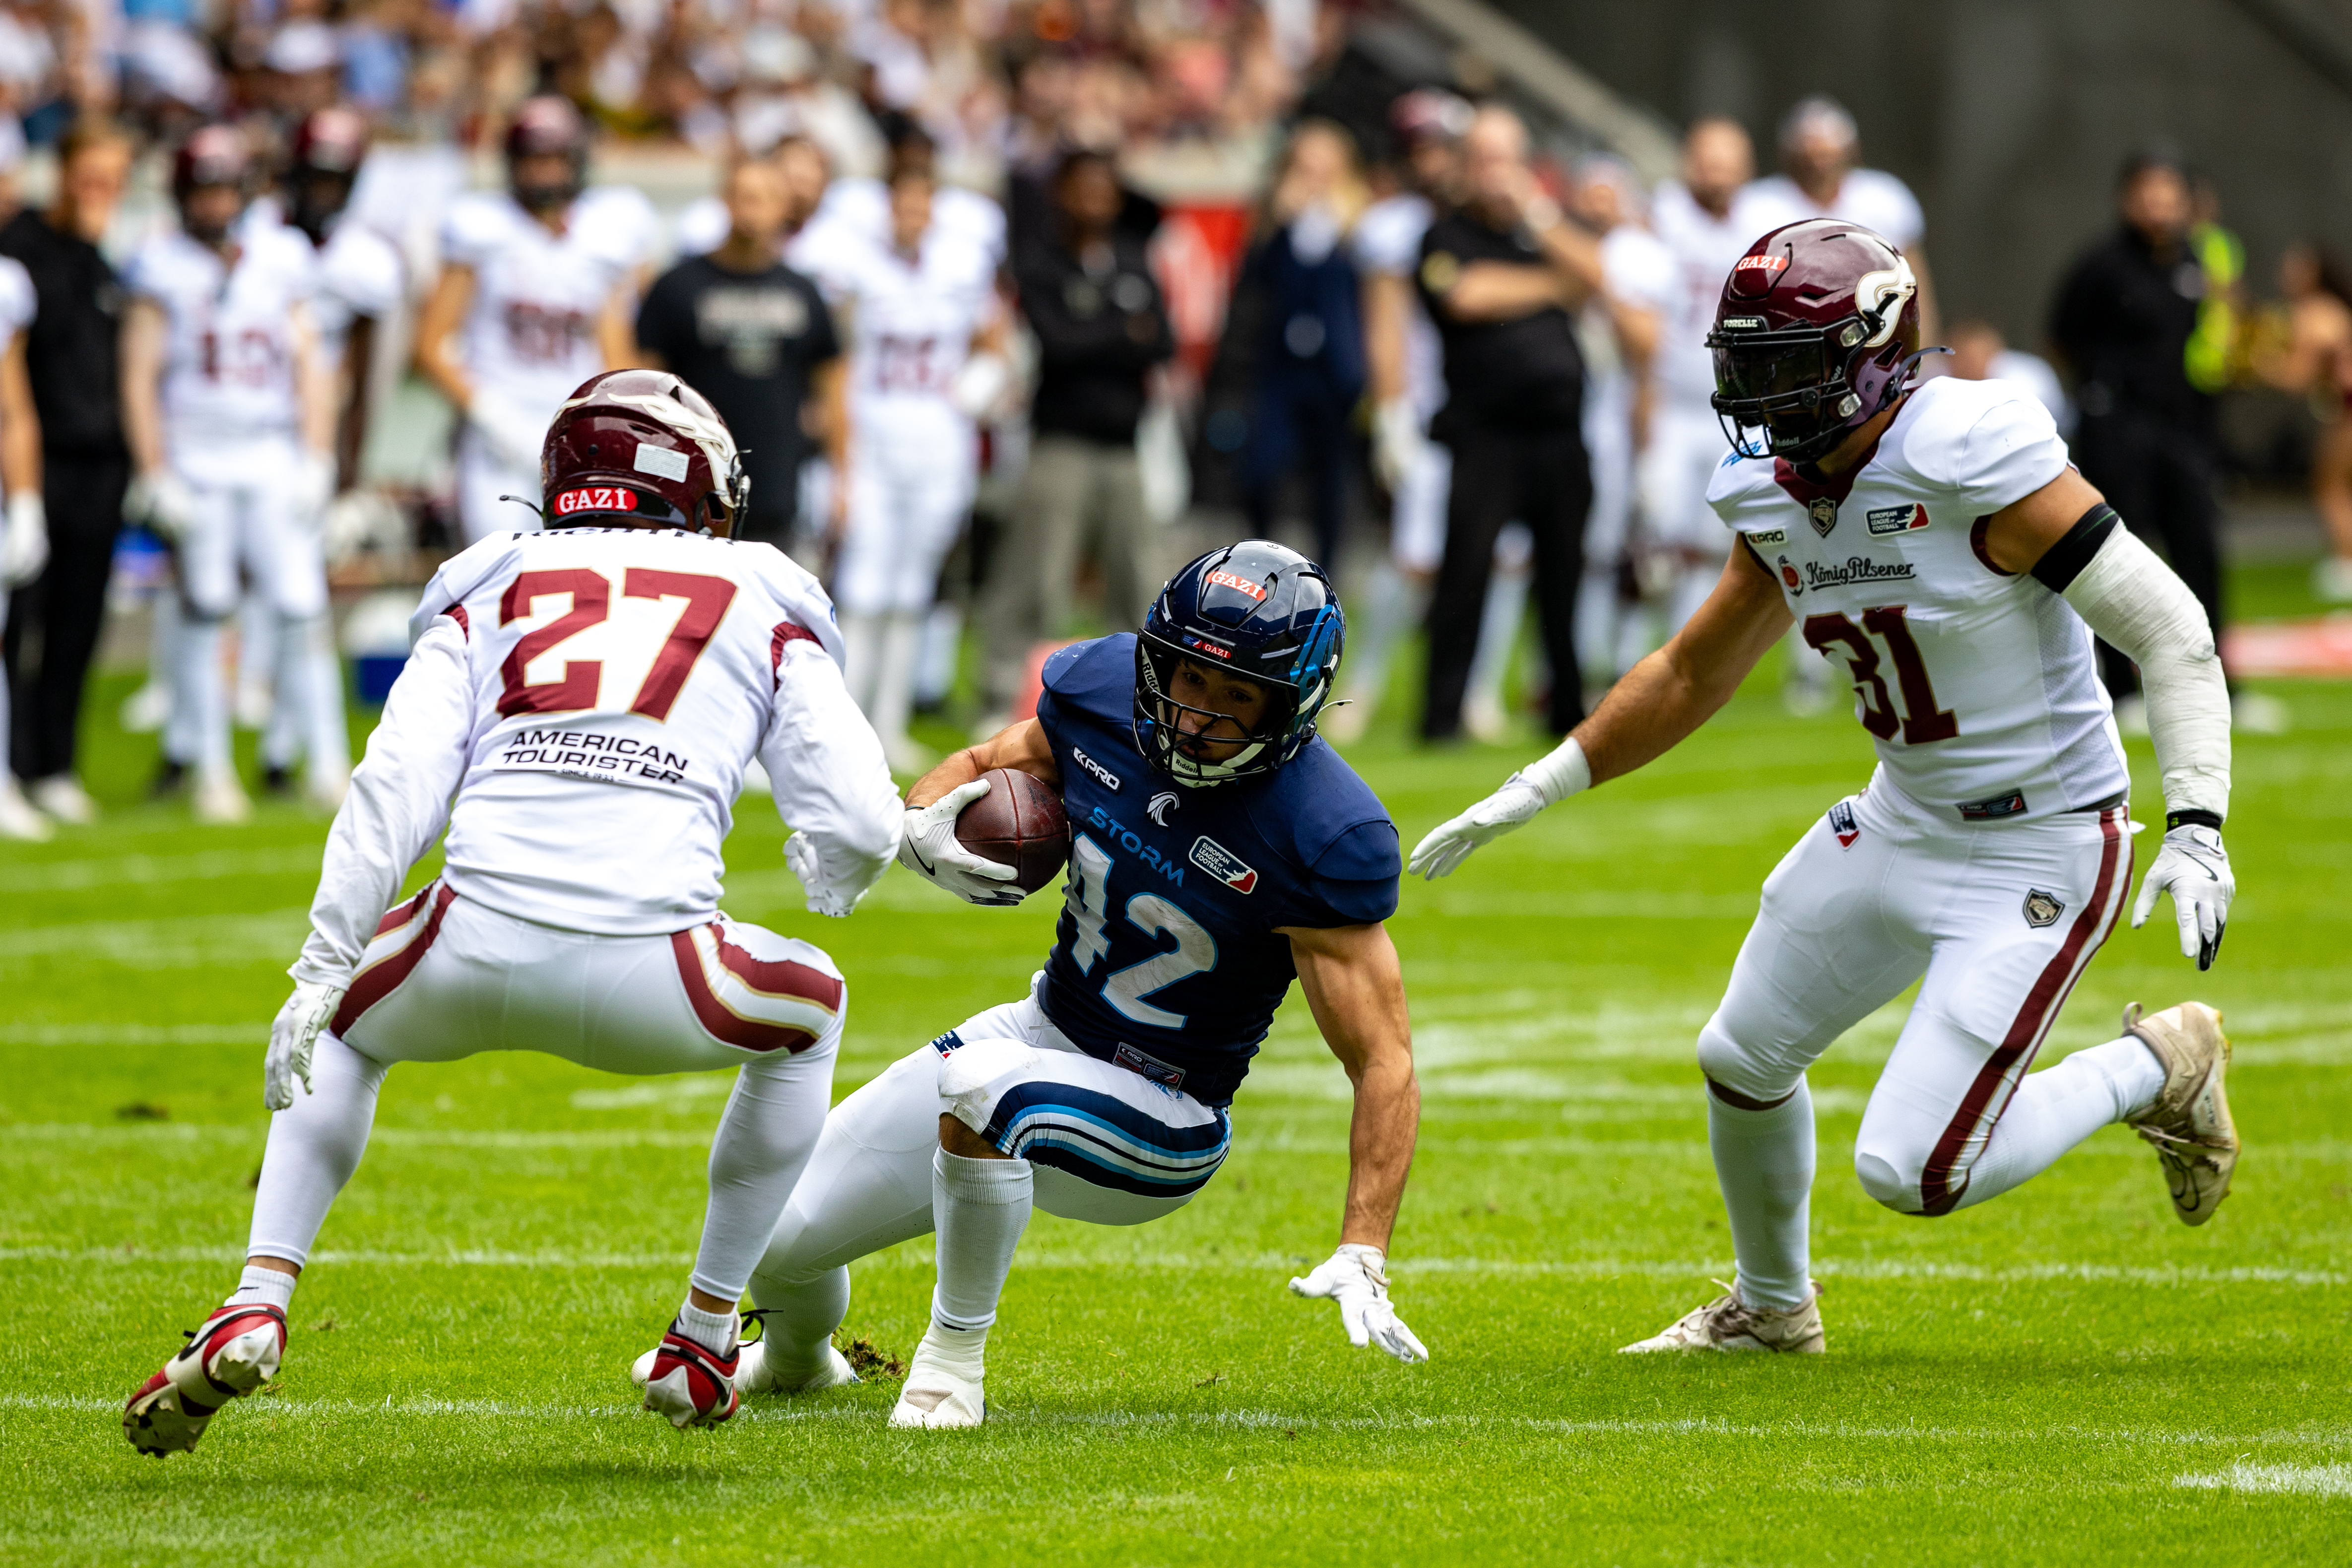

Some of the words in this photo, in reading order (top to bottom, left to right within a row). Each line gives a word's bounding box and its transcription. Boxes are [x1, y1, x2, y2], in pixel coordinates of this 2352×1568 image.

[1870, 511, 1897, 520] EUROPEAN
[1872, 523, 1899, 531] FOOTBALL
[495, 566, 739, 725] 27
[1803, 604, 1960, 745] 31
[509, 730, 688, 771] AMERICAN
[503, 750, 684, 784] TOURISTER
[560, 769, 589, 780] SINCE
[1089, 806, 1185, 887] STORM
[1199, 848, 1219, 864] LEAGUE
[1202, 843, 1230, 865] EUROPEAN
[1195, 853, 1222, 875] FOOTBALL
[1063, 831, 1219, 1031] 42
